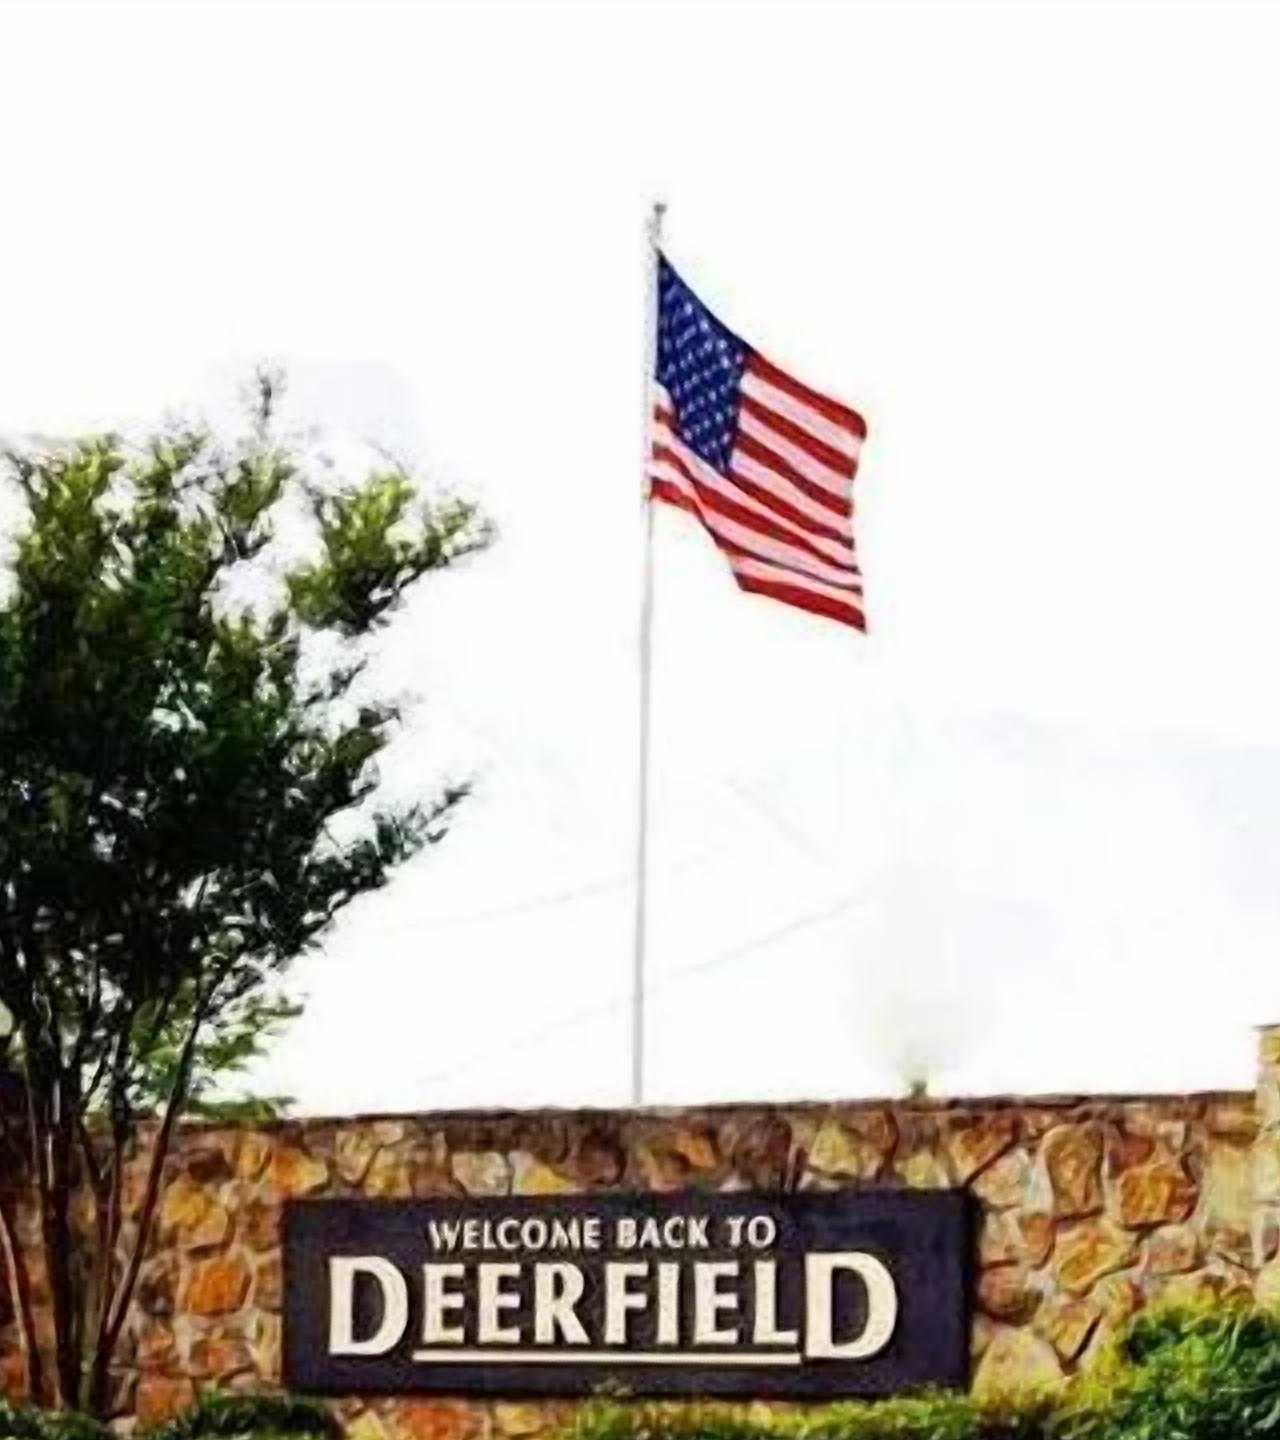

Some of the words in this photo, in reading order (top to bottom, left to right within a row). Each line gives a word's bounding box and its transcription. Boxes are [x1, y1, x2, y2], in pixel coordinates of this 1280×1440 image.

[428, 1218, 602, 1251] WELCOME
[615, 1215, 710, 1250] BACK
[726, 1214, 777, 1249] TO
[327, 1251, 899, 1360] DEERFIELD
